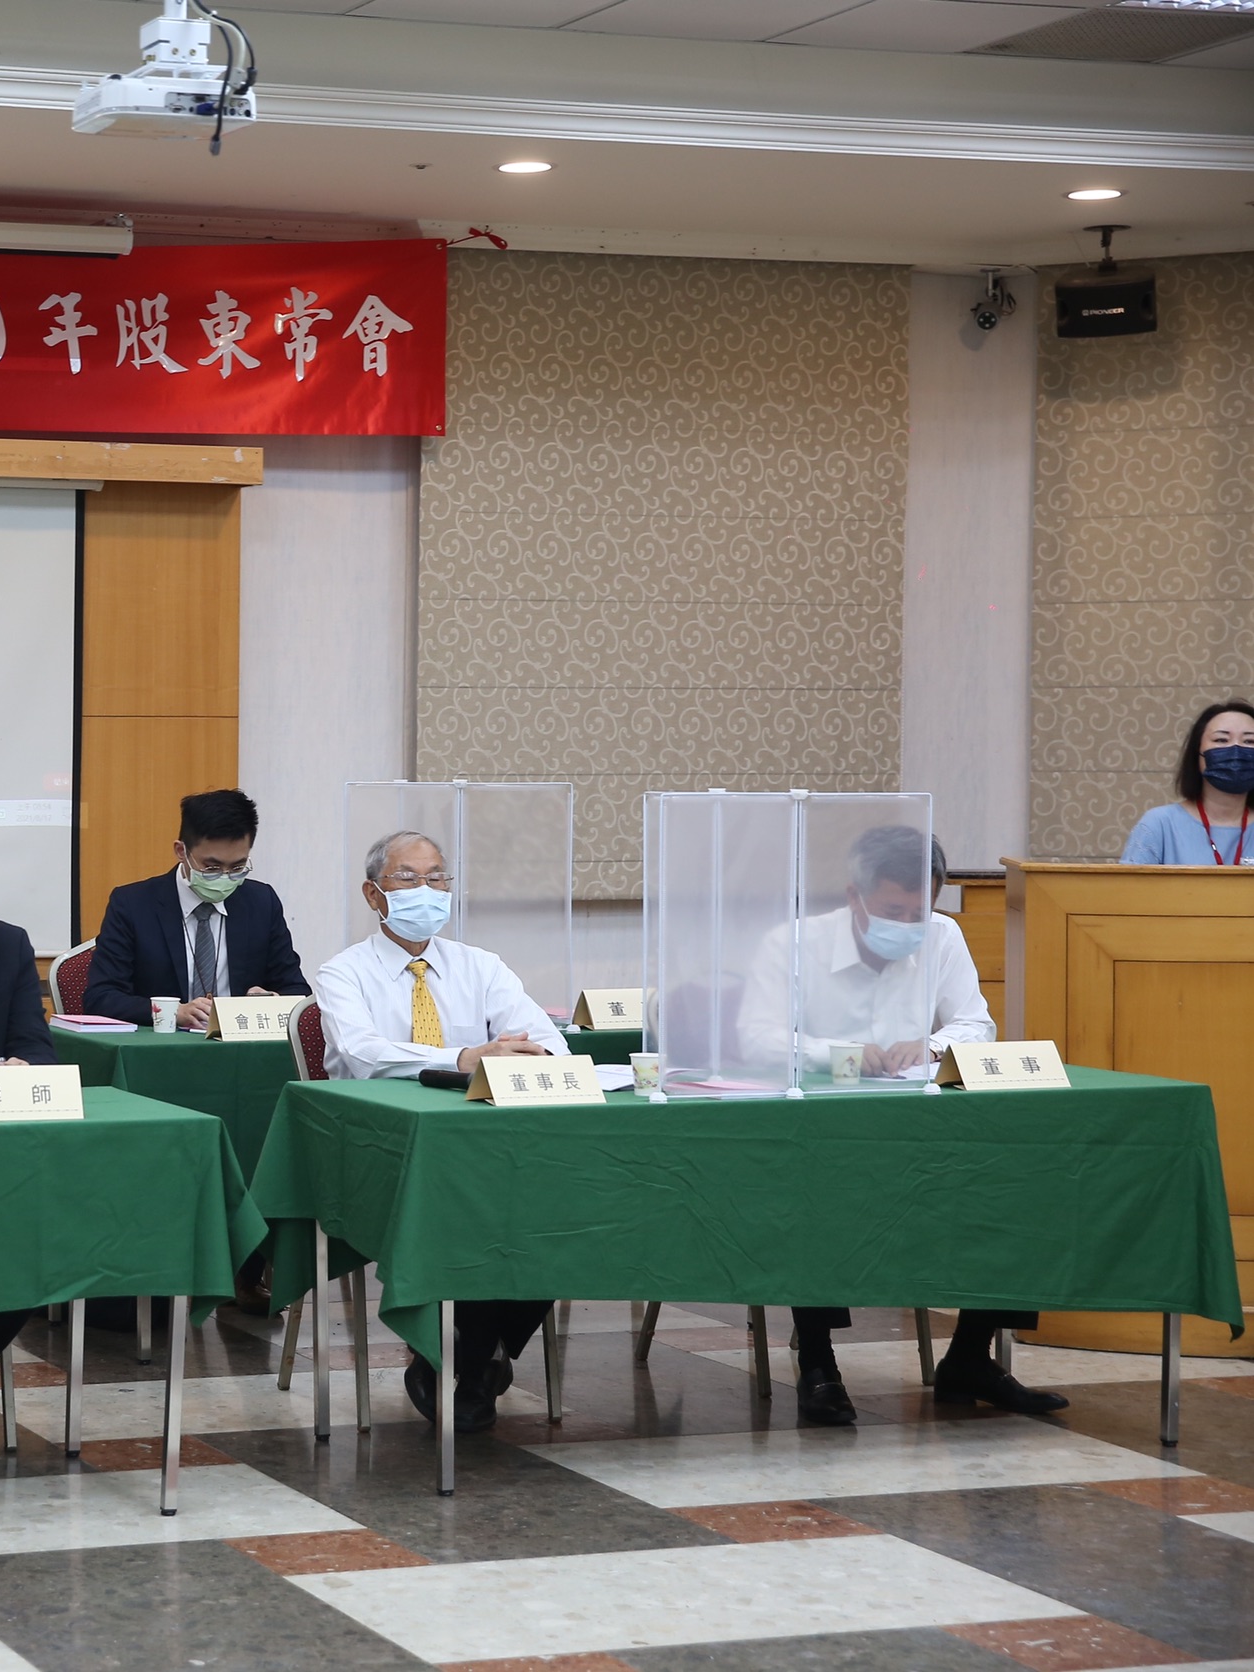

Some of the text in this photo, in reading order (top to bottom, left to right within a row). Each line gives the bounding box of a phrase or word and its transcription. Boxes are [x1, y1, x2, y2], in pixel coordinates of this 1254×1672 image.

[607, 1001, 643, 1017] 董
[979, 1055, 1041, 1076] 董事
[508, 1071, 581, 1092] 董事長
